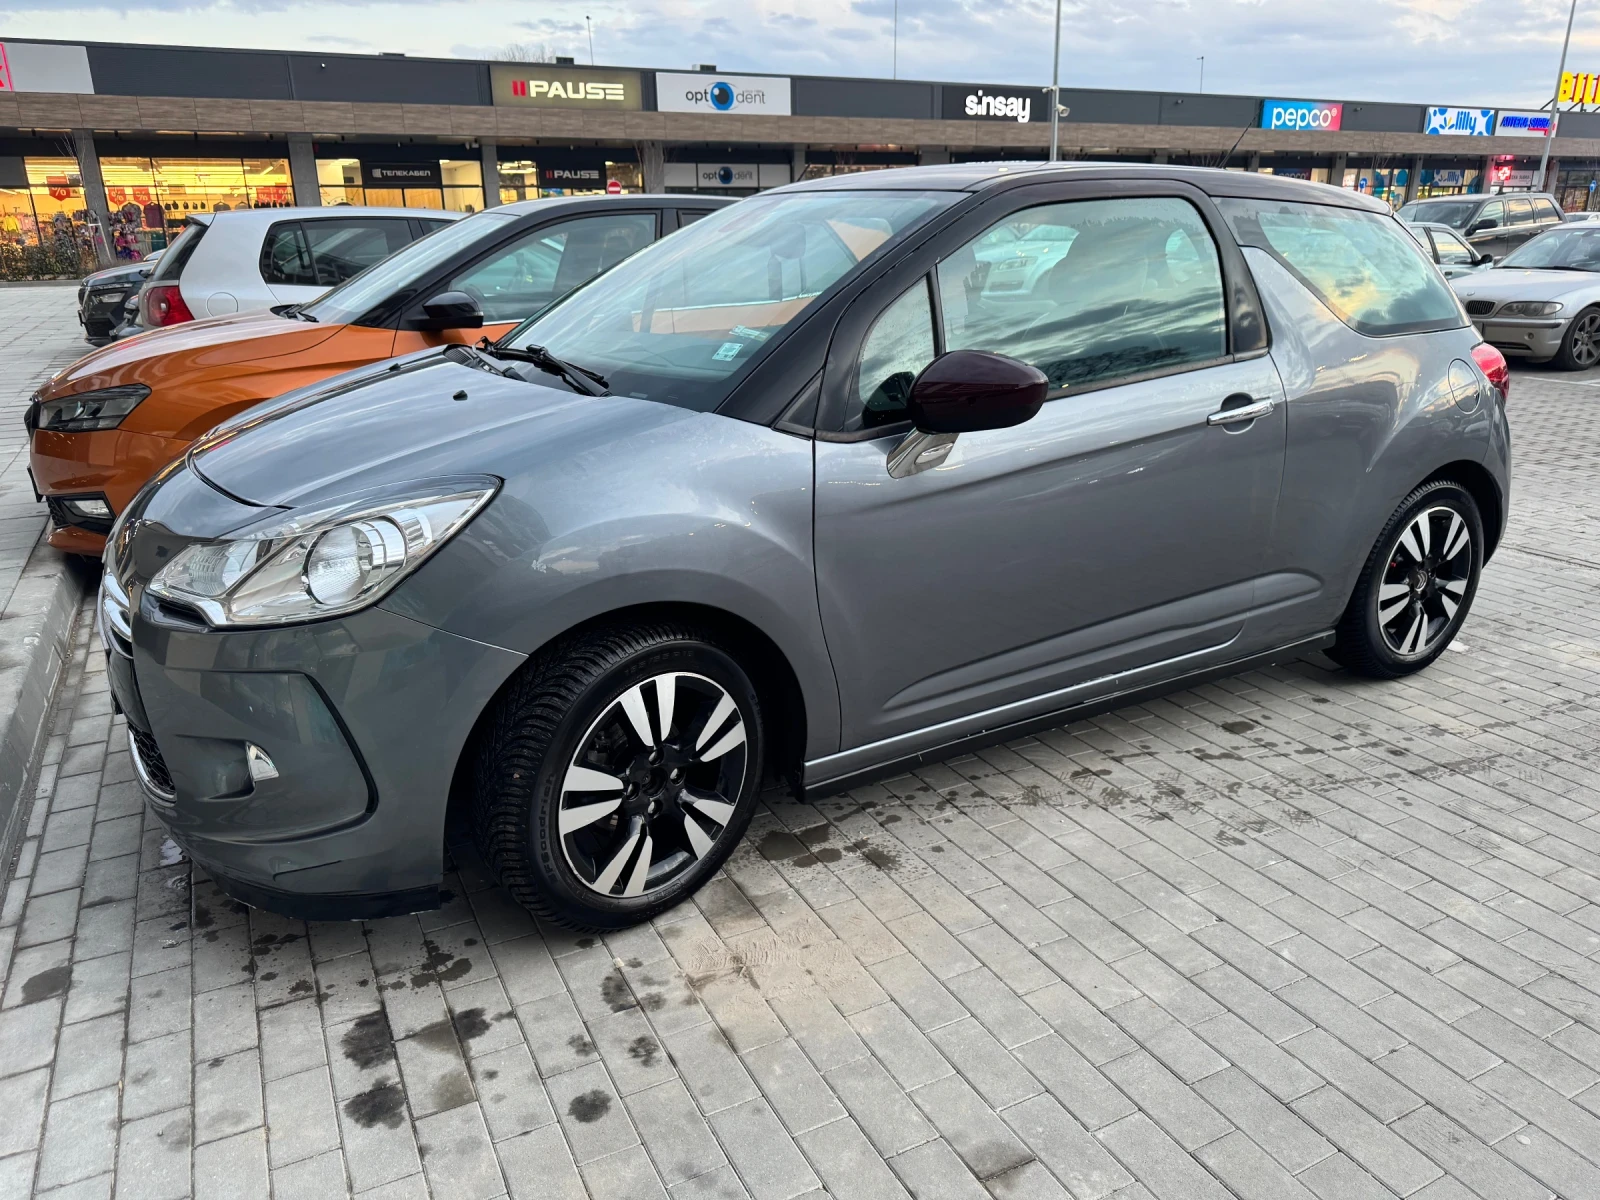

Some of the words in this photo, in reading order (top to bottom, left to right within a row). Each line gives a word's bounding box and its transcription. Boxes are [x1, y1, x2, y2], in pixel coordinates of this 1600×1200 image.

[529, 80, 624, 100] PAUSE
[965, 89, 1031, 123] sinsay
[1455, 111, 1477, 135] lilly
[554, 170, 599, 179] PAUSE
